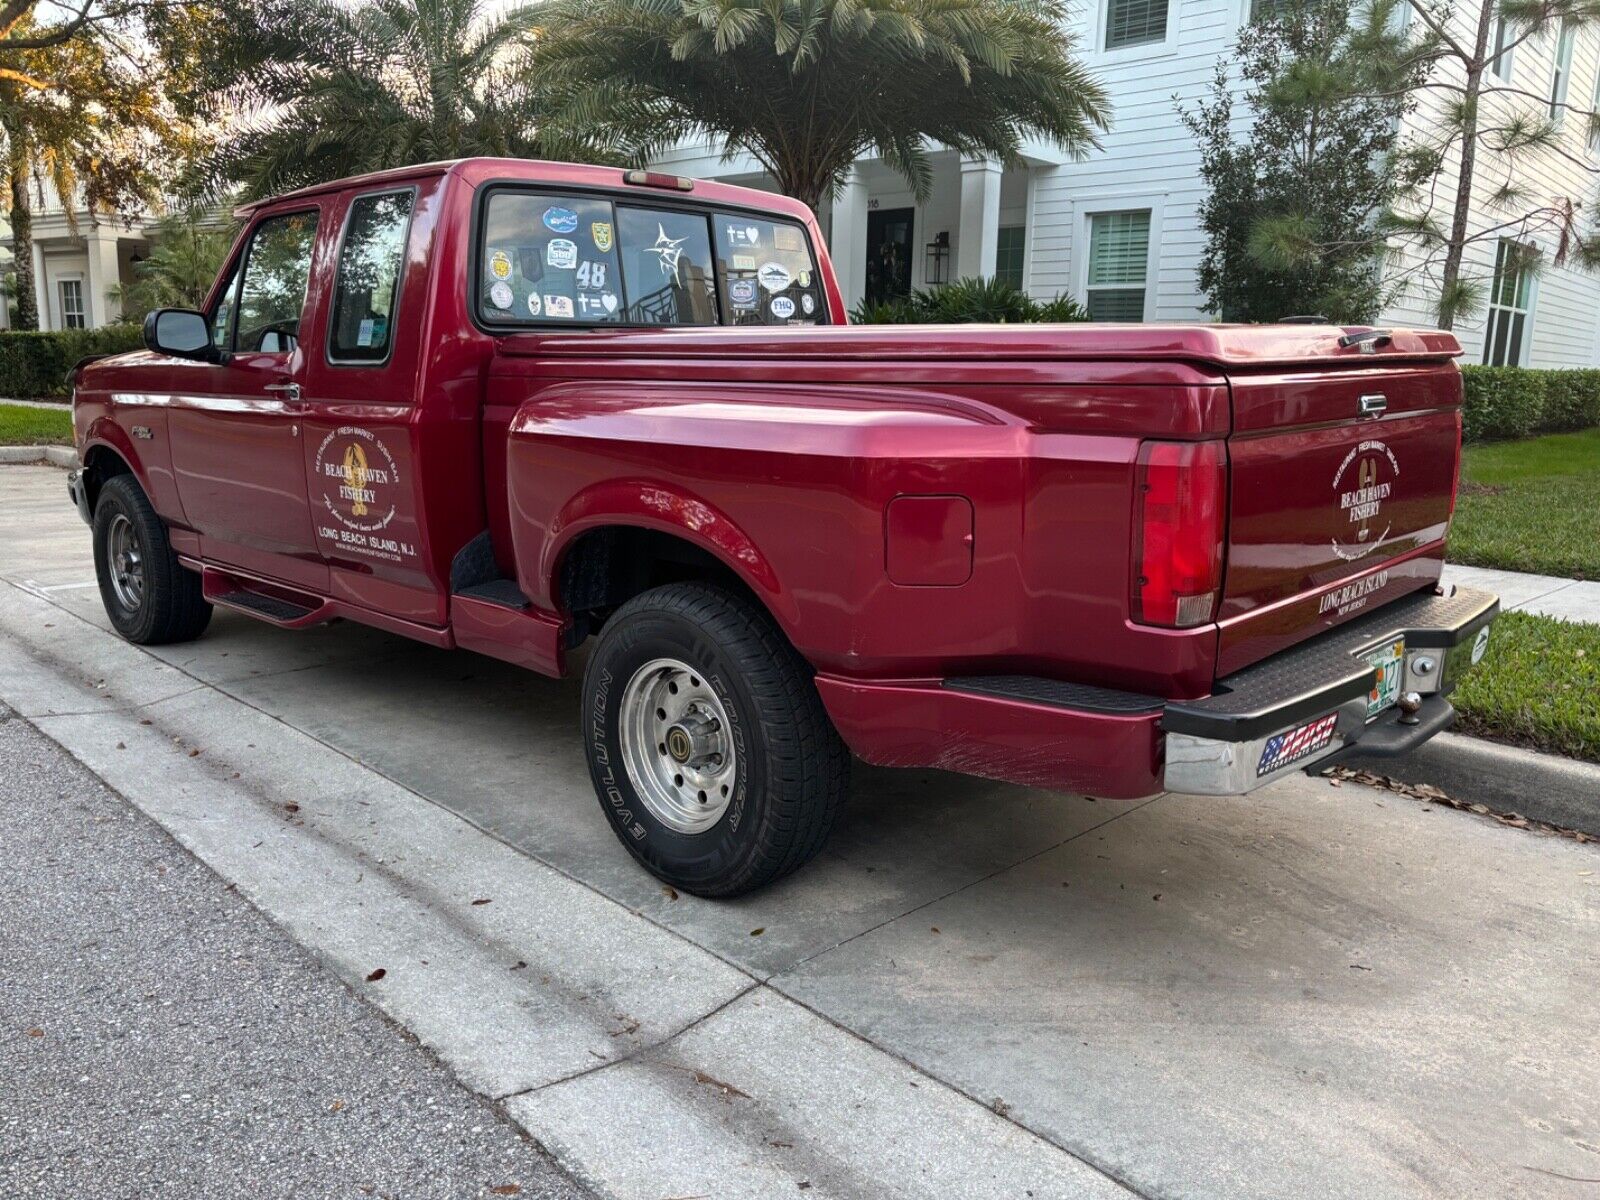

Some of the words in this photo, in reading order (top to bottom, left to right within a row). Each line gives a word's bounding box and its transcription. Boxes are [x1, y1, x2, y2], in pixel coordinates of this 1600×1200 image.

[576, 260, 606, 290] 48
[774, 300, 793, 311] FHQ
[337, 426, 353, 436] FRESH
[354, 427, 375, 441] MARKET
[325, 463, 353, 480] BEACH
[358, 468, 388, 485] HAVEN
[340, 485, 376, 504] FISHERY
[1341, 489, 1367, 510] BEACH
[1367, 482, 1391, 503] HAVEN
[1350, 501, 1381, 523] FISHERY
[318, 526, 339, 540] LONG
[341, 530, 367, 546] BEACH
[369, 536, 401, 554] ISLAND,
[401, 543, 418, 557] N.J.
[1319, 588, 1342, 615] LONG
[1340, 581, 1364, 605] BEACH
[1364, 570, 1388, 595] ISLAND
[1337, 604, 1350, 617] NEW
[1349, 597, 1368, 612] JERSEY
[594, 667, 647, 842] EVOLUTION
[710, 673, 748, 833] COOPER
